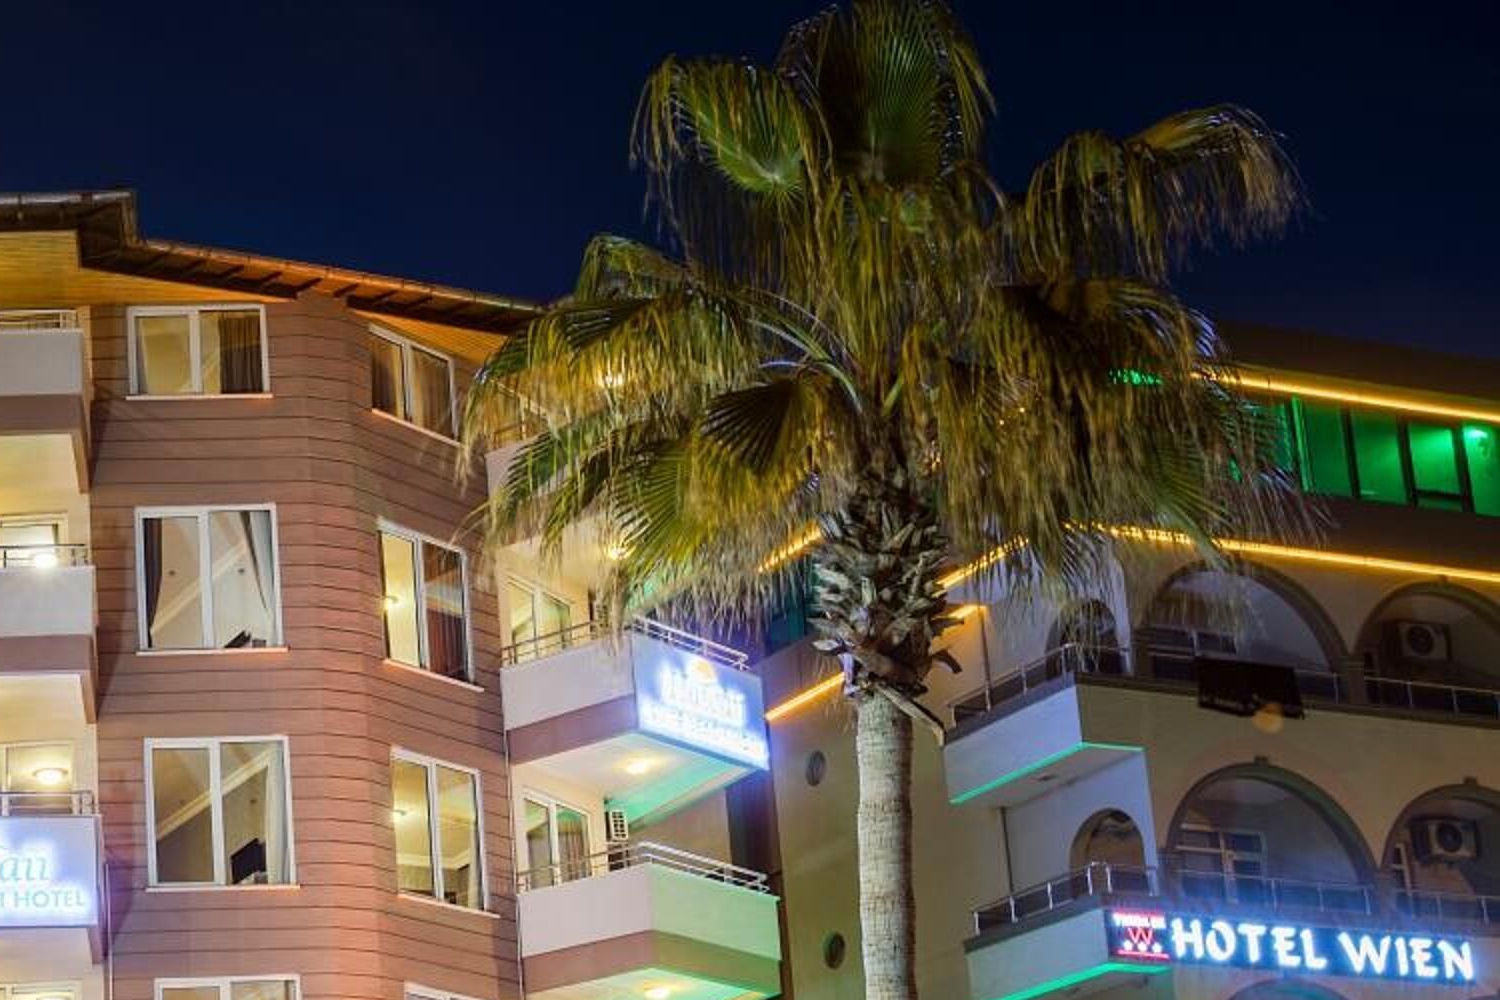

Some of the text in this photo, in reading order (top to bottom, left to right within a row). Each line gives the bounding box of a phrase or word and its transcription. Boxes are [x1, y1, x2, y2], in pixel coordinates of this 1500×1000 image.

[13, 888, 85, 909] HOTEL
[1171, 918, 1474, 981] HOTEL WIEN
